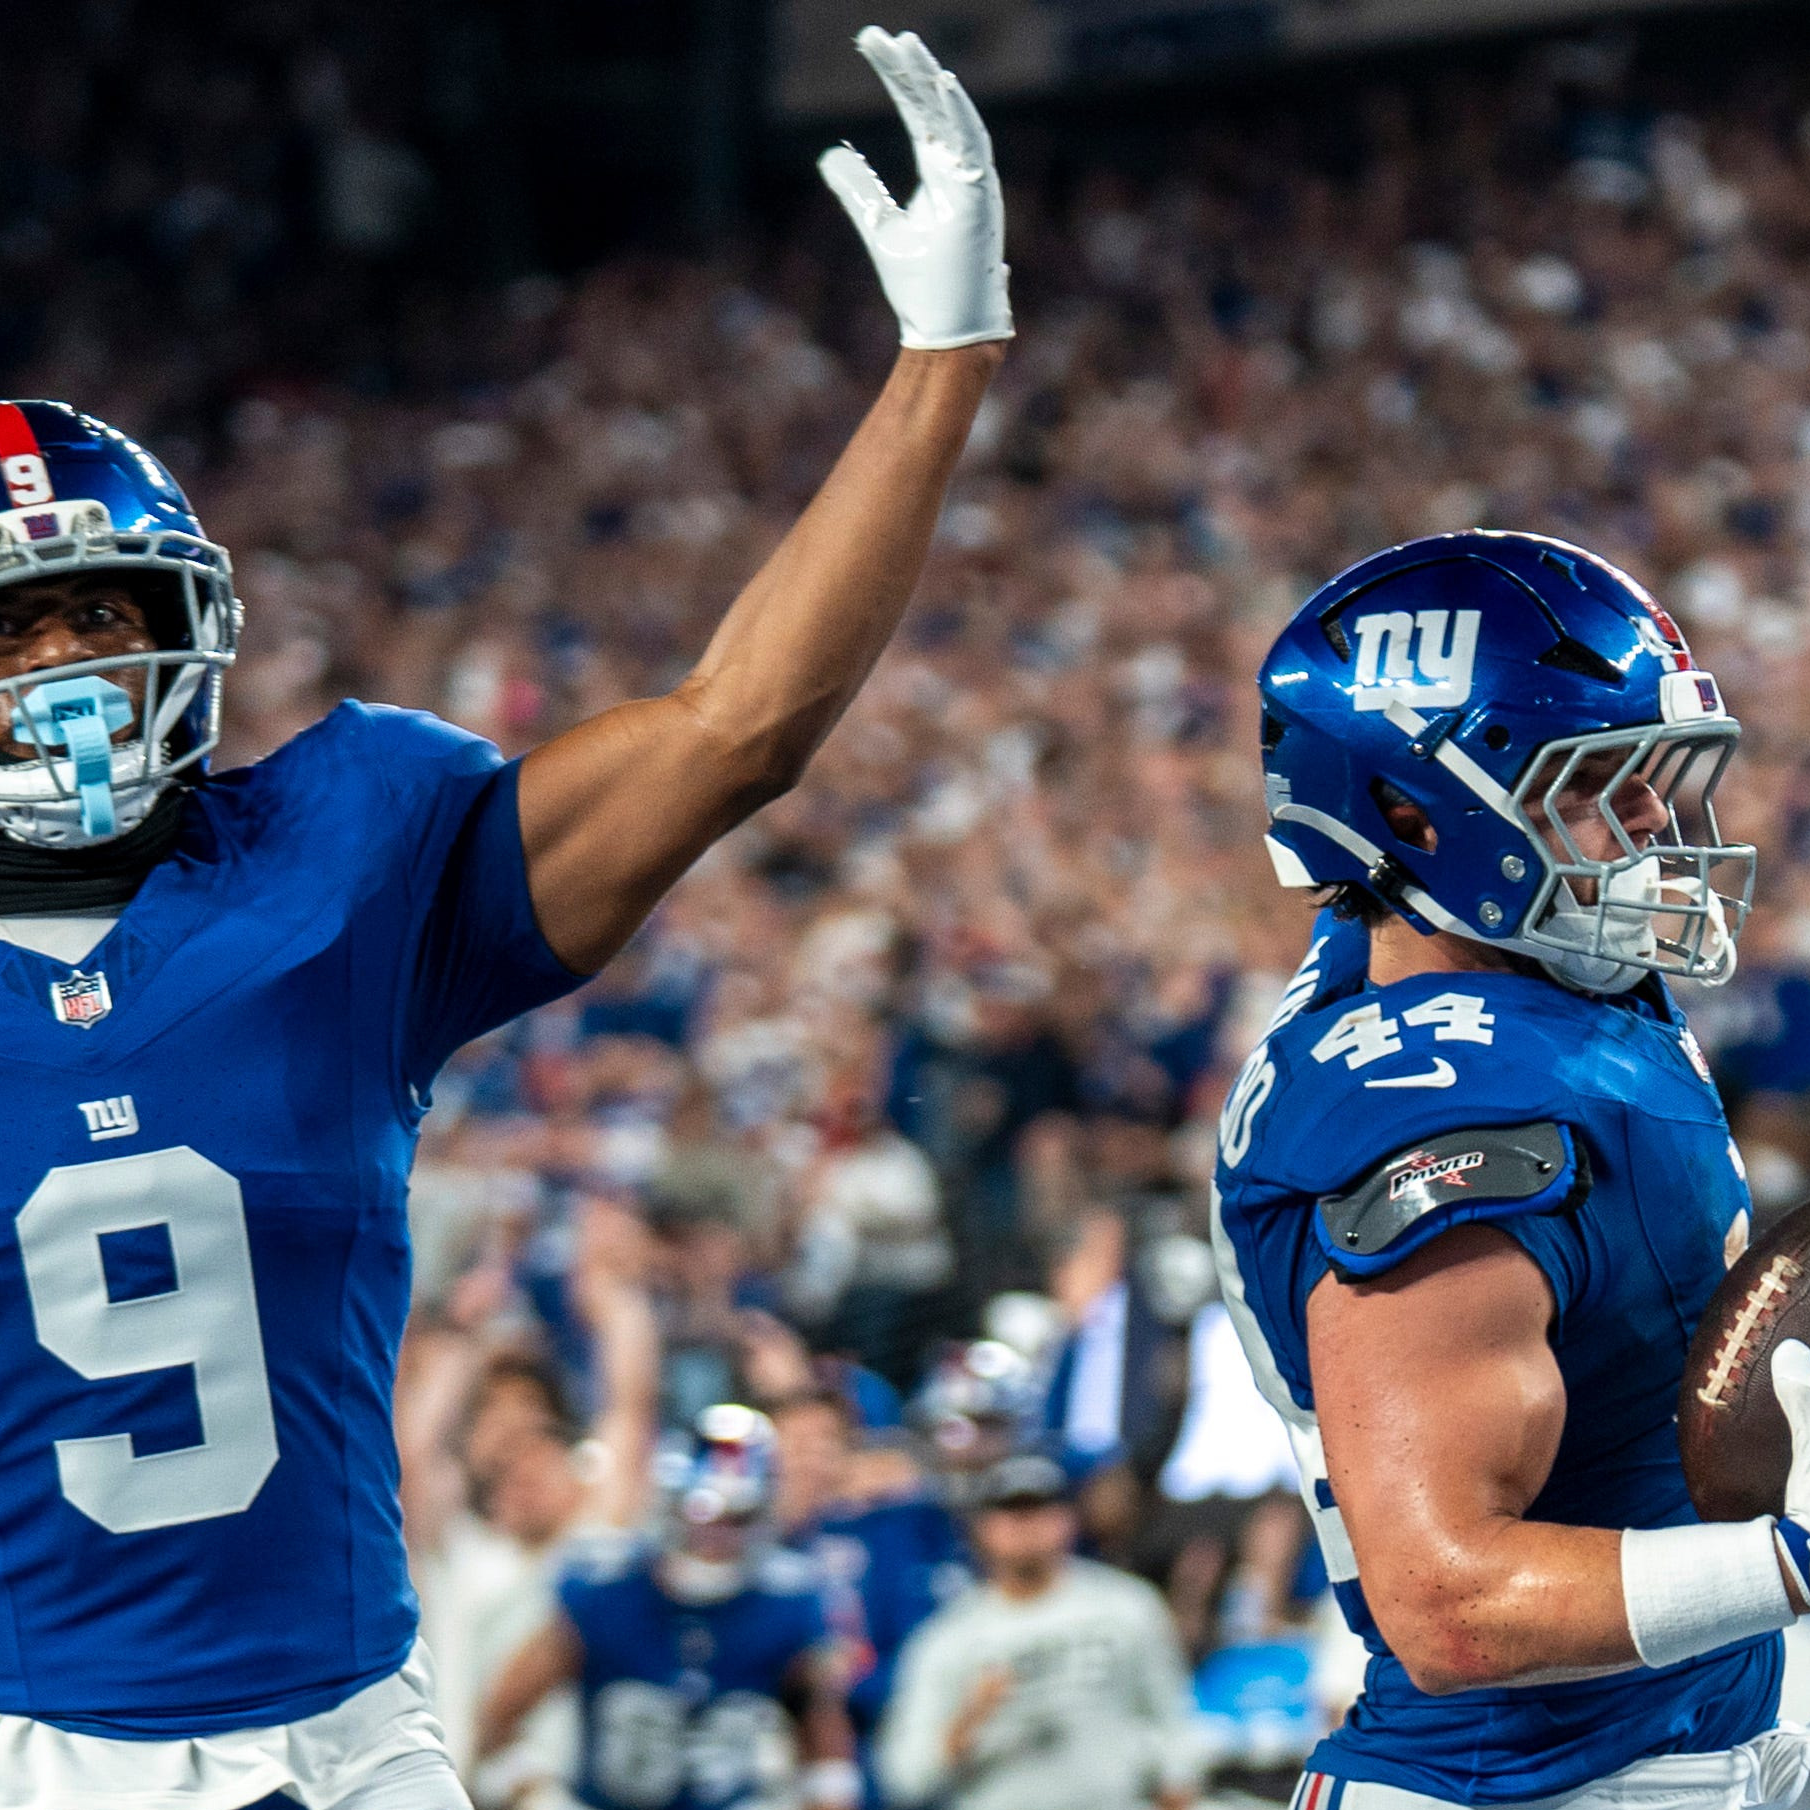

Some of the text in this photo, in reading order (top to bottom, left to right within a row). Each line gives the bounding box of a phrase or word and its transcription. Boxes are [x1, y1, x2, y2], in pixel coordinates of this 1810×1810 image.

[4, 452, 53, 505] 9
[1310, 992, 1495, 1070] 44
[15, 1145, 280, 1534] 9
